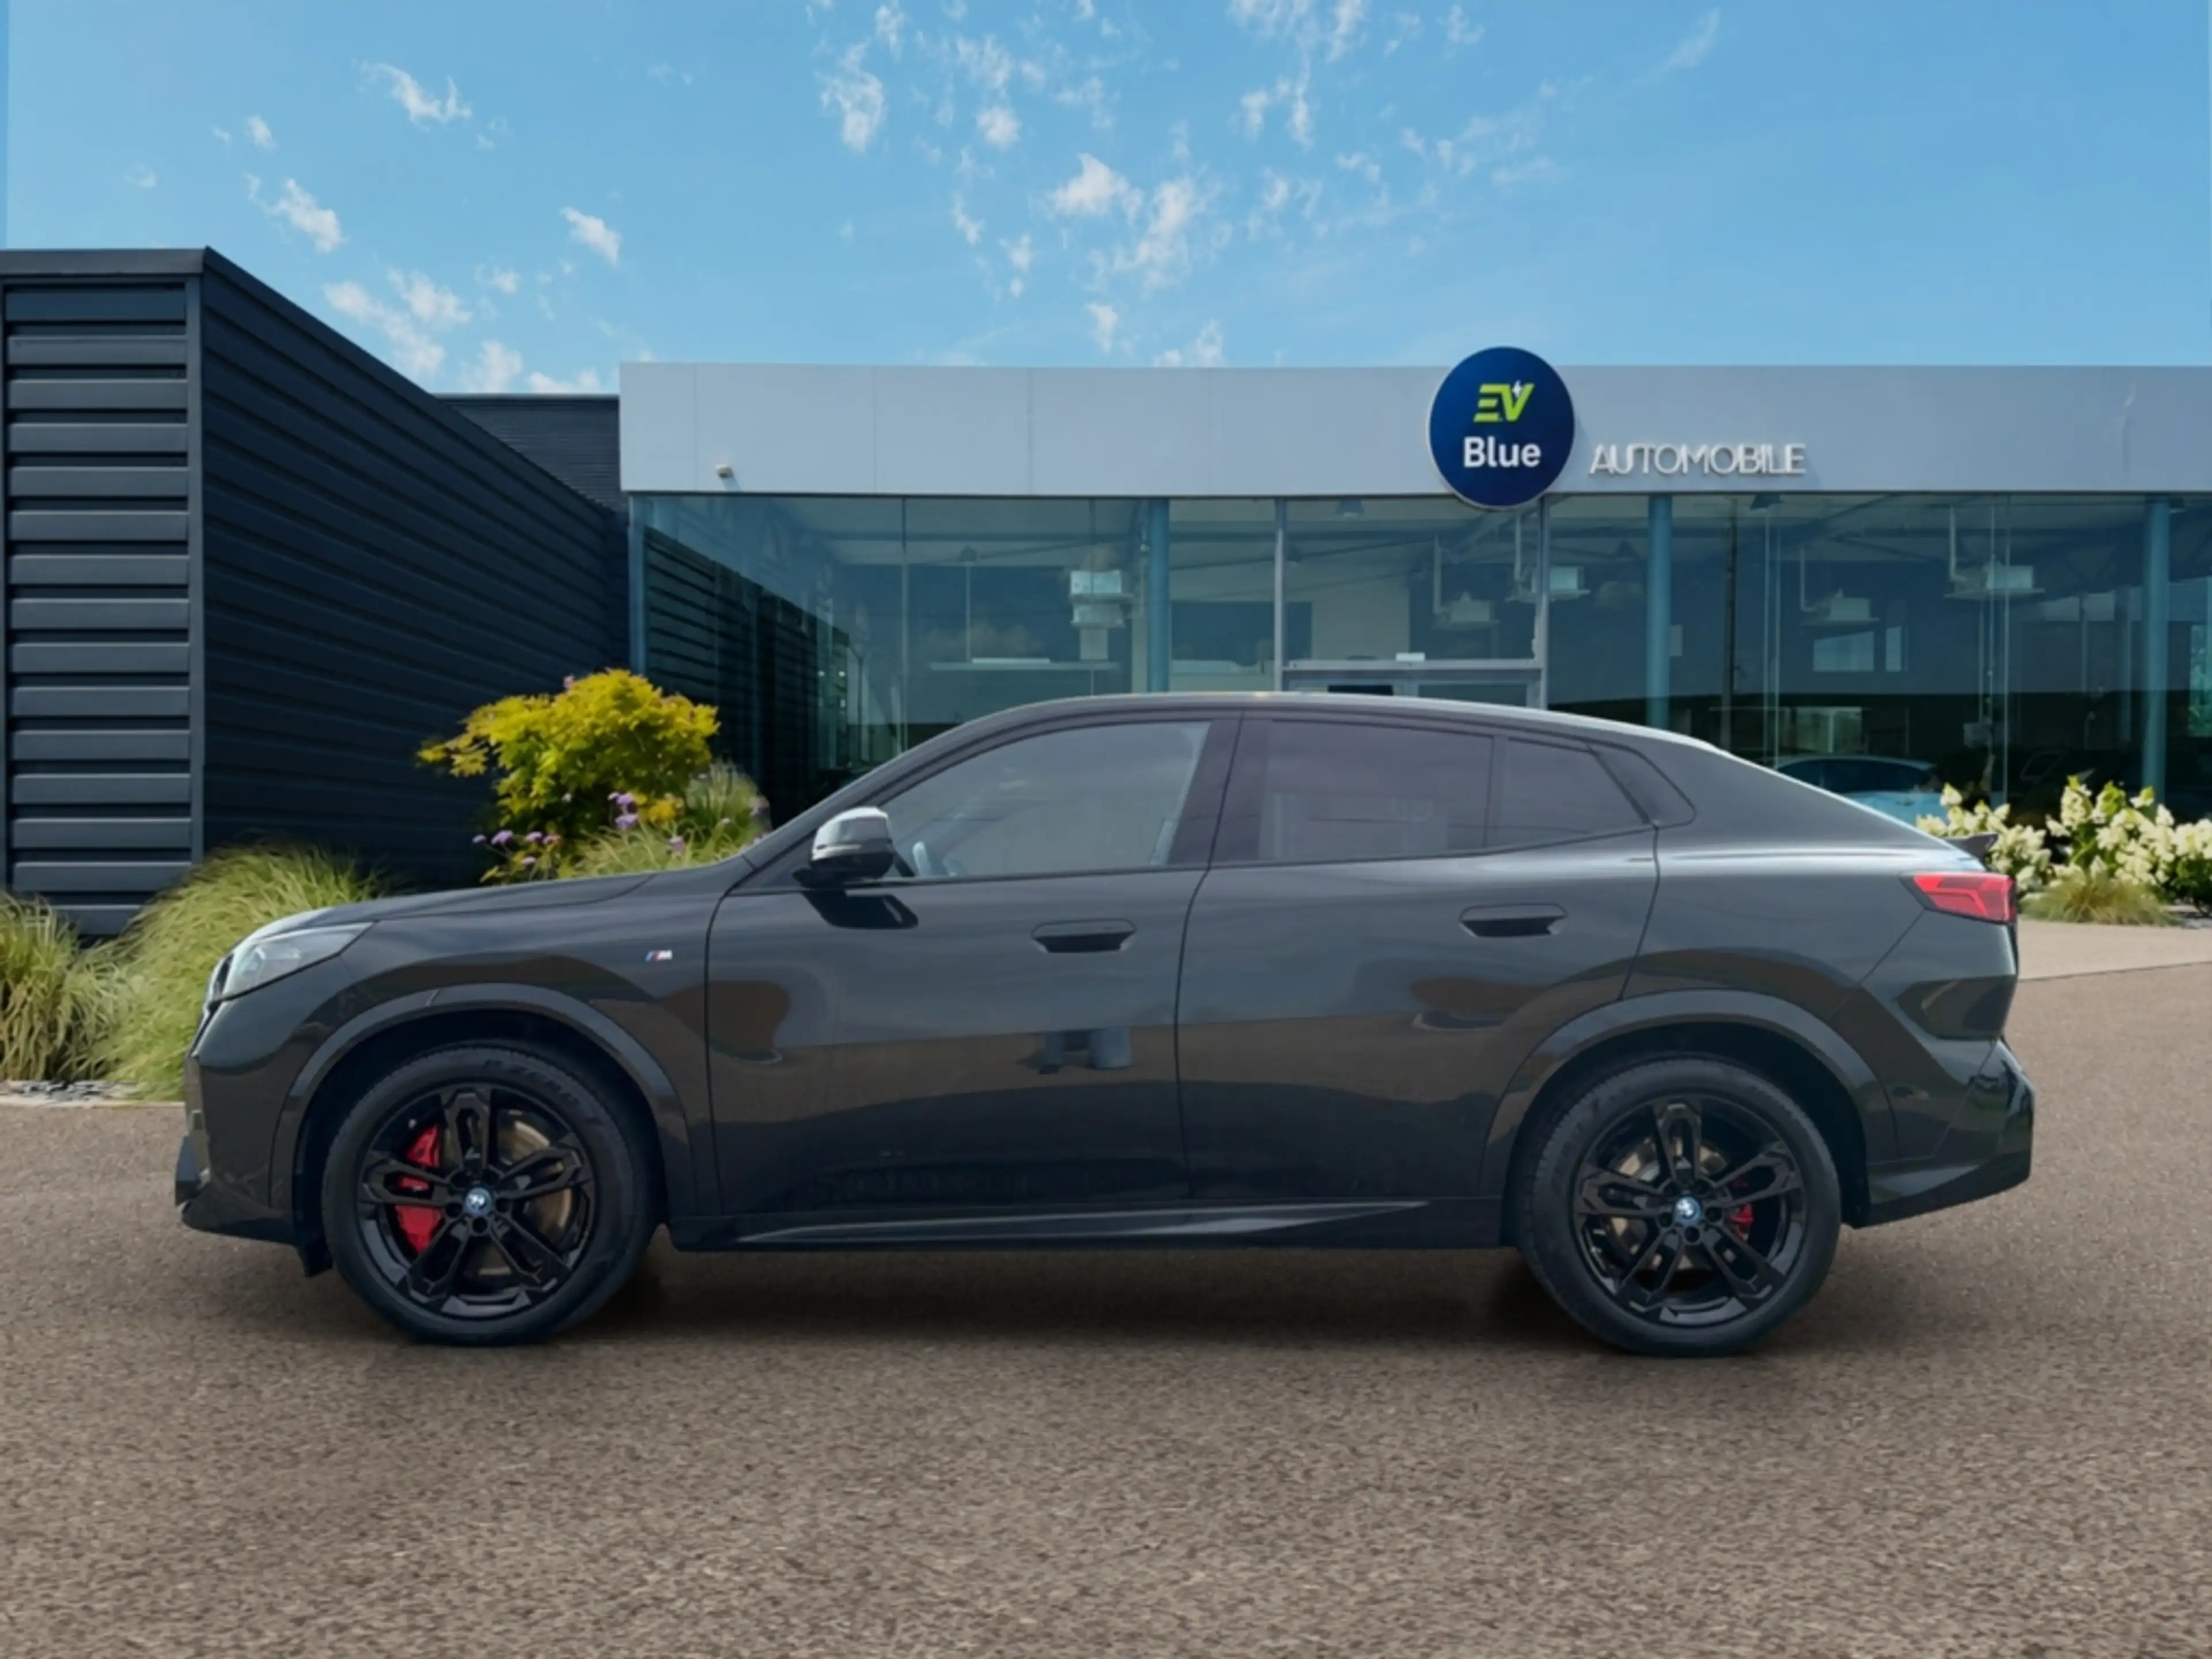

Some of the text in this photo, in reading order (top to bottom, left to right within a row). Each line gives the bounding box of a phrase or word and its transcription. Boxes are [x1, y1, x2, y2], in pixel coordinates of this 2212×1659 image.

[1473, 381, 1535, 423] EV
[1464, 435, 1542, 468] Blue
[1589, 444, 1806, 474] AUTOMOBILE
